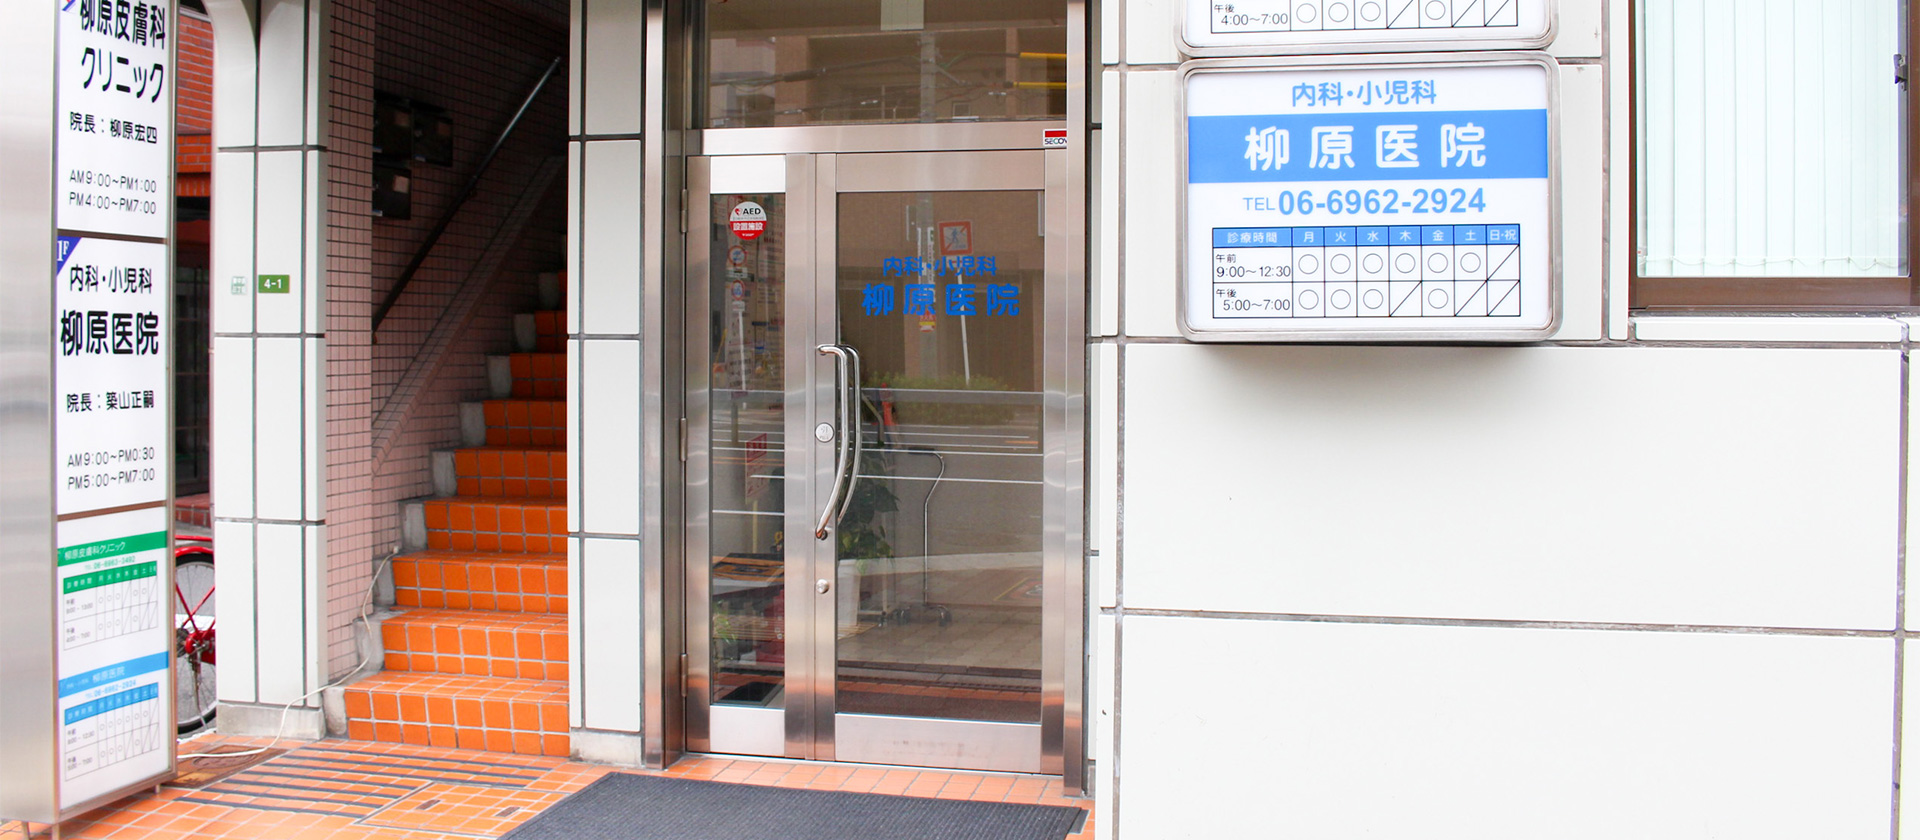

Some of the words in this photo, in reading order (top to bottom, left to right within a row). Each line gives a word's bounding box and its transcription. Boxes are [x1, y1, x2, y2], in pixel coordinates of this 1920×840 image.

[1214, 4, 1235, 13] 午後
[80, 0, 165, 49] 柳原皮膚科
[81, 46, 164, 103] クリニック
[1292, 79, 1437, 107] 内科・小児科
[1244, 122, 1487, 171] 柳原医院
[743, 207, 761, 215] AED
[1242, 197, 1276, 211] TEL
[1278, 187, 1487, 216] 06-6962-2924
[1227, 232, 1278, 243] 診療時間
[1303, 231, 1315, 243] 月
[1335, 231, 1347, 242] 火
[1367, 231, 1379, 242] 水
[1399, 230, 1412, 242] 木
[1432, 230, 1444, 242] 金
[1465, 230, 1477, 241] 土
[1489, 229, 1517, 241] 日・祝
[57, 240, 70, 262] 1F
[1216, 254, 1237, 264] 午前
[883, 256, 997, 277] 内科・小児科
[70, 264, 152, 295] 内科・小児科
[263, 278, 282, 289] 4-1
[861, 283, 1020, 316] 柳原医院
[1216, 288, 1237, 298] 午後
[60, 309, 159, 356] 柳原医院
